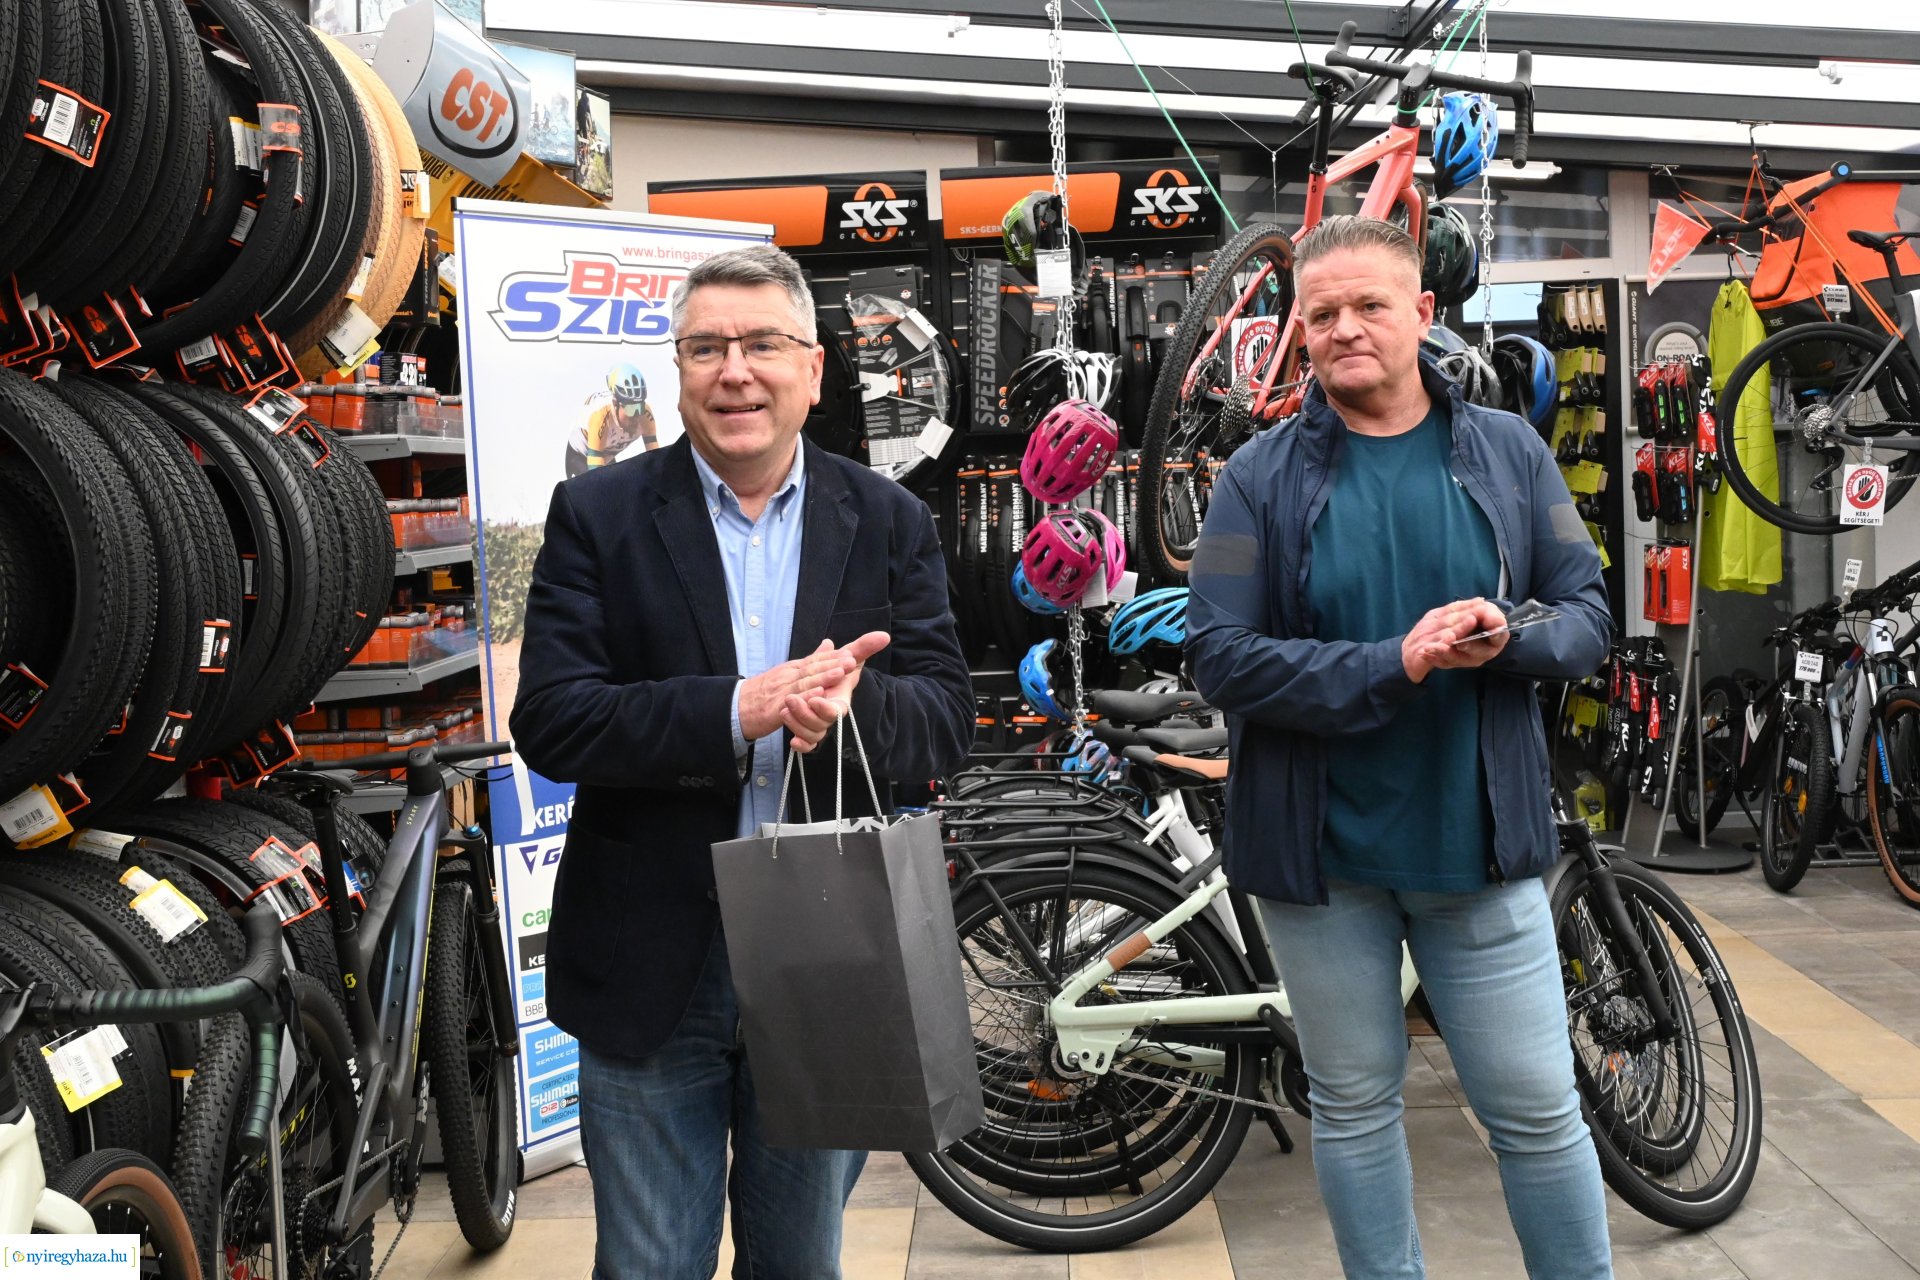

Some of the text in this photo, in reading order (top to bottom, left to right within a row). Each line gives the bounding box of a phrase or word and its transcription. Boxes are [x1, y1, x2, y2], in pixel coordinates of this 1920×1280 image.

[441, 67, 509, 143] CST
[1131, 186, 1202, 214] SKS
[840, 200, 910, 228] SKS
[1129, 216, 1207, 227] GERMANY
[839, 230, 916, 240] GERMANY
[974, 263, 998, 426] SPEEDROCKER
[1668, 449, 1686, 468] KLS
[980, 483, 988, 520] GERMANY
[1012, 483, 1020, 520] GERMANY
[980, 531, 988, 552] MADE
[406, 804, 419, 826] SPARK
[525, 1003, 544, 1017] BBB
[535, 1051, 565, 1066] SERVICE
